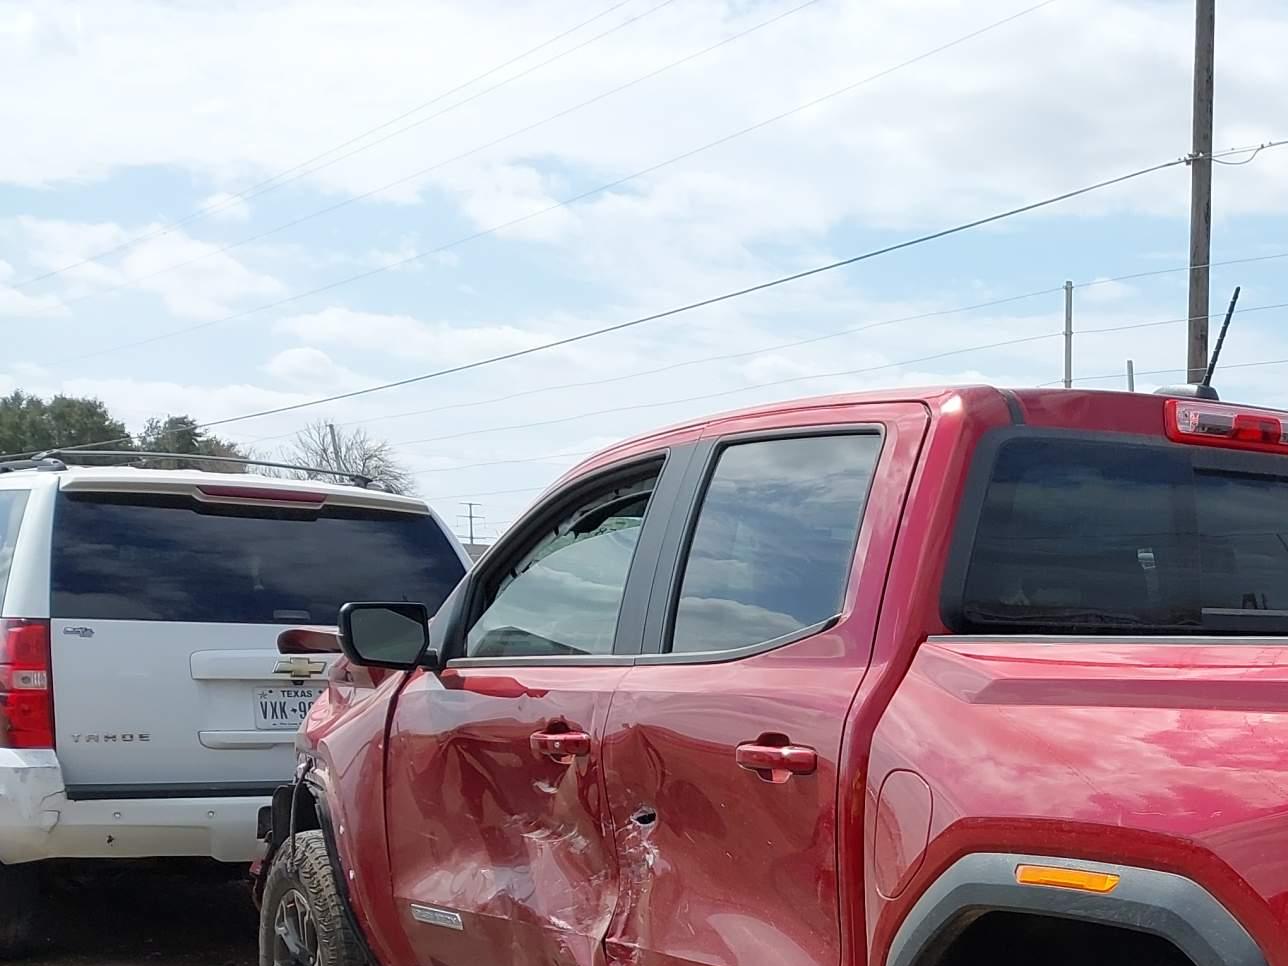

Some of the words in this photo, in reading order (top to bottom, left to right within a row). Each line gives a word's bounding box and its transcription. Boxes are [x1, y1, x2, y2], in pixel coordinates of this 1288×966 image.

[281, 690, 313, 698] TEXAS
[260, 701, 288, 720] VXK
[71, 733, 152, 743] TAHOE
